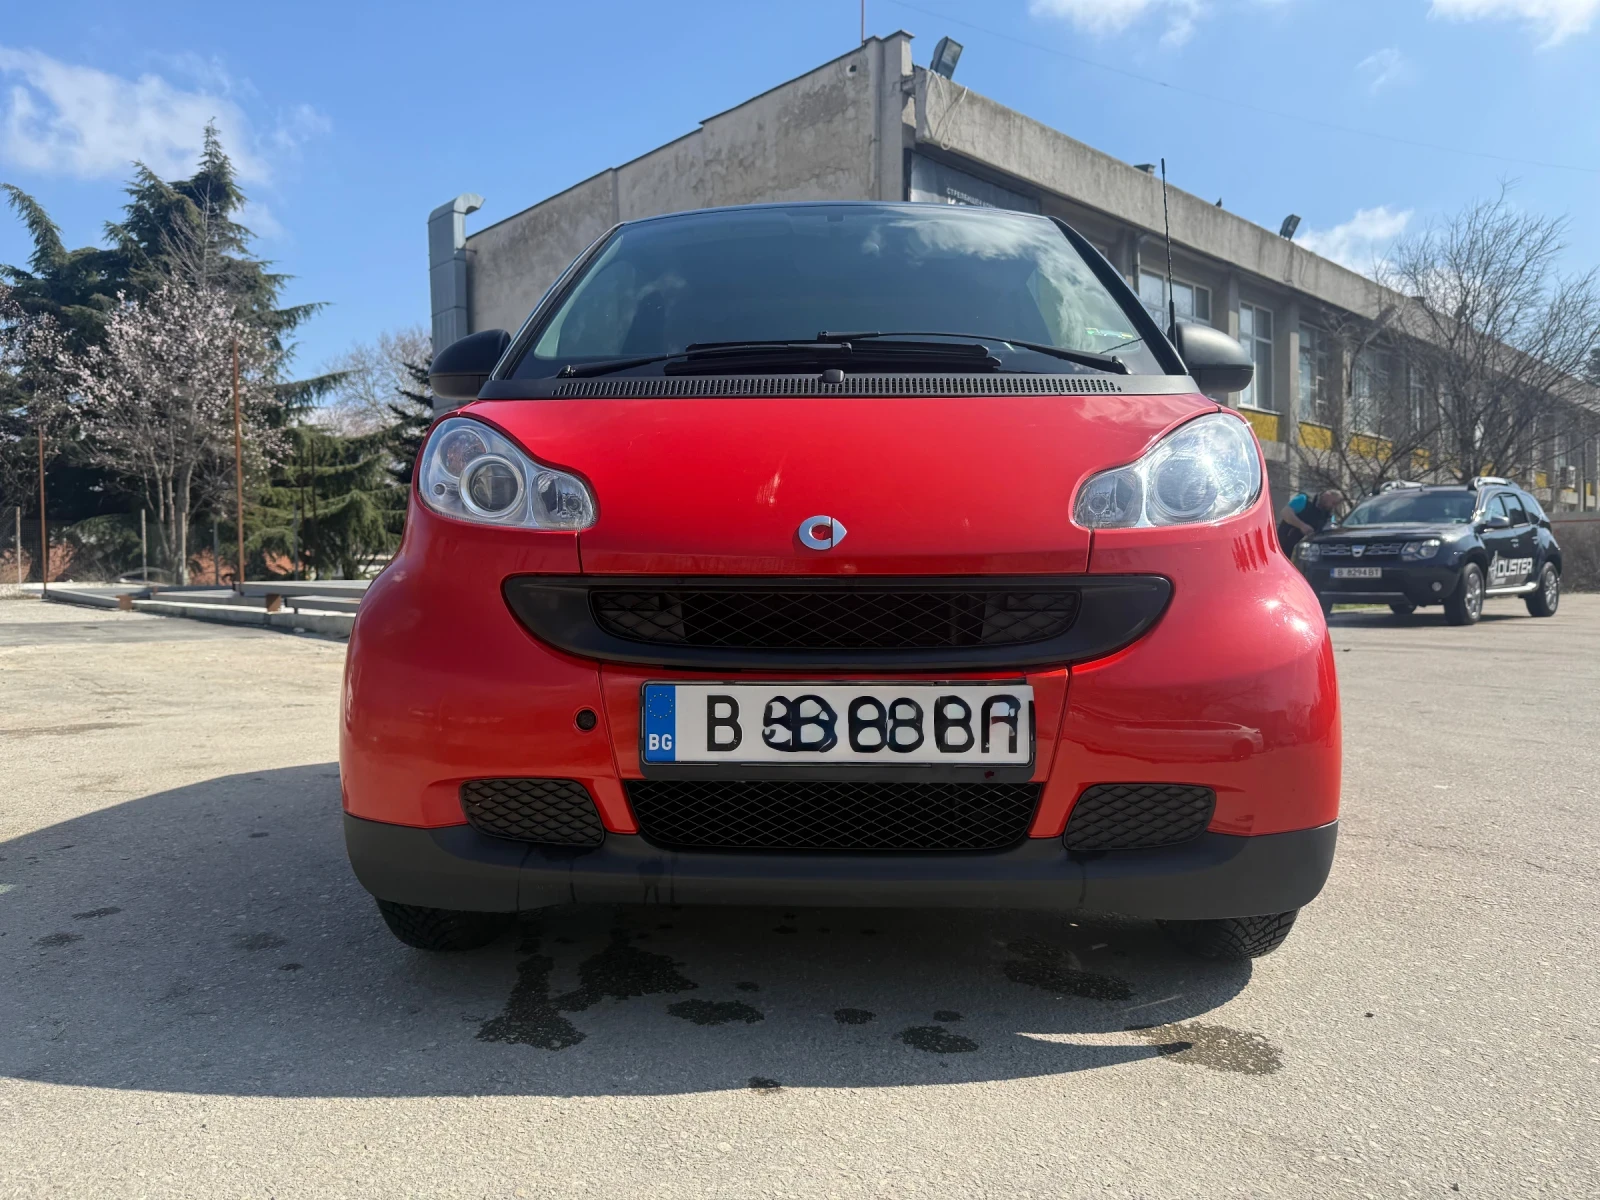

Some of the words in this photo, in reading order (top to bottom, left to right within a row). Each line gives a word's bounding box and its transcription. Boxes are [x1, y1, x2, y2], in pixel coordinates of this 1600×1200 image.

[1497, 557, 1532, 577] DUSTER
[706, 695, 742, 751] B
[648, 733, 672, 751] BG
